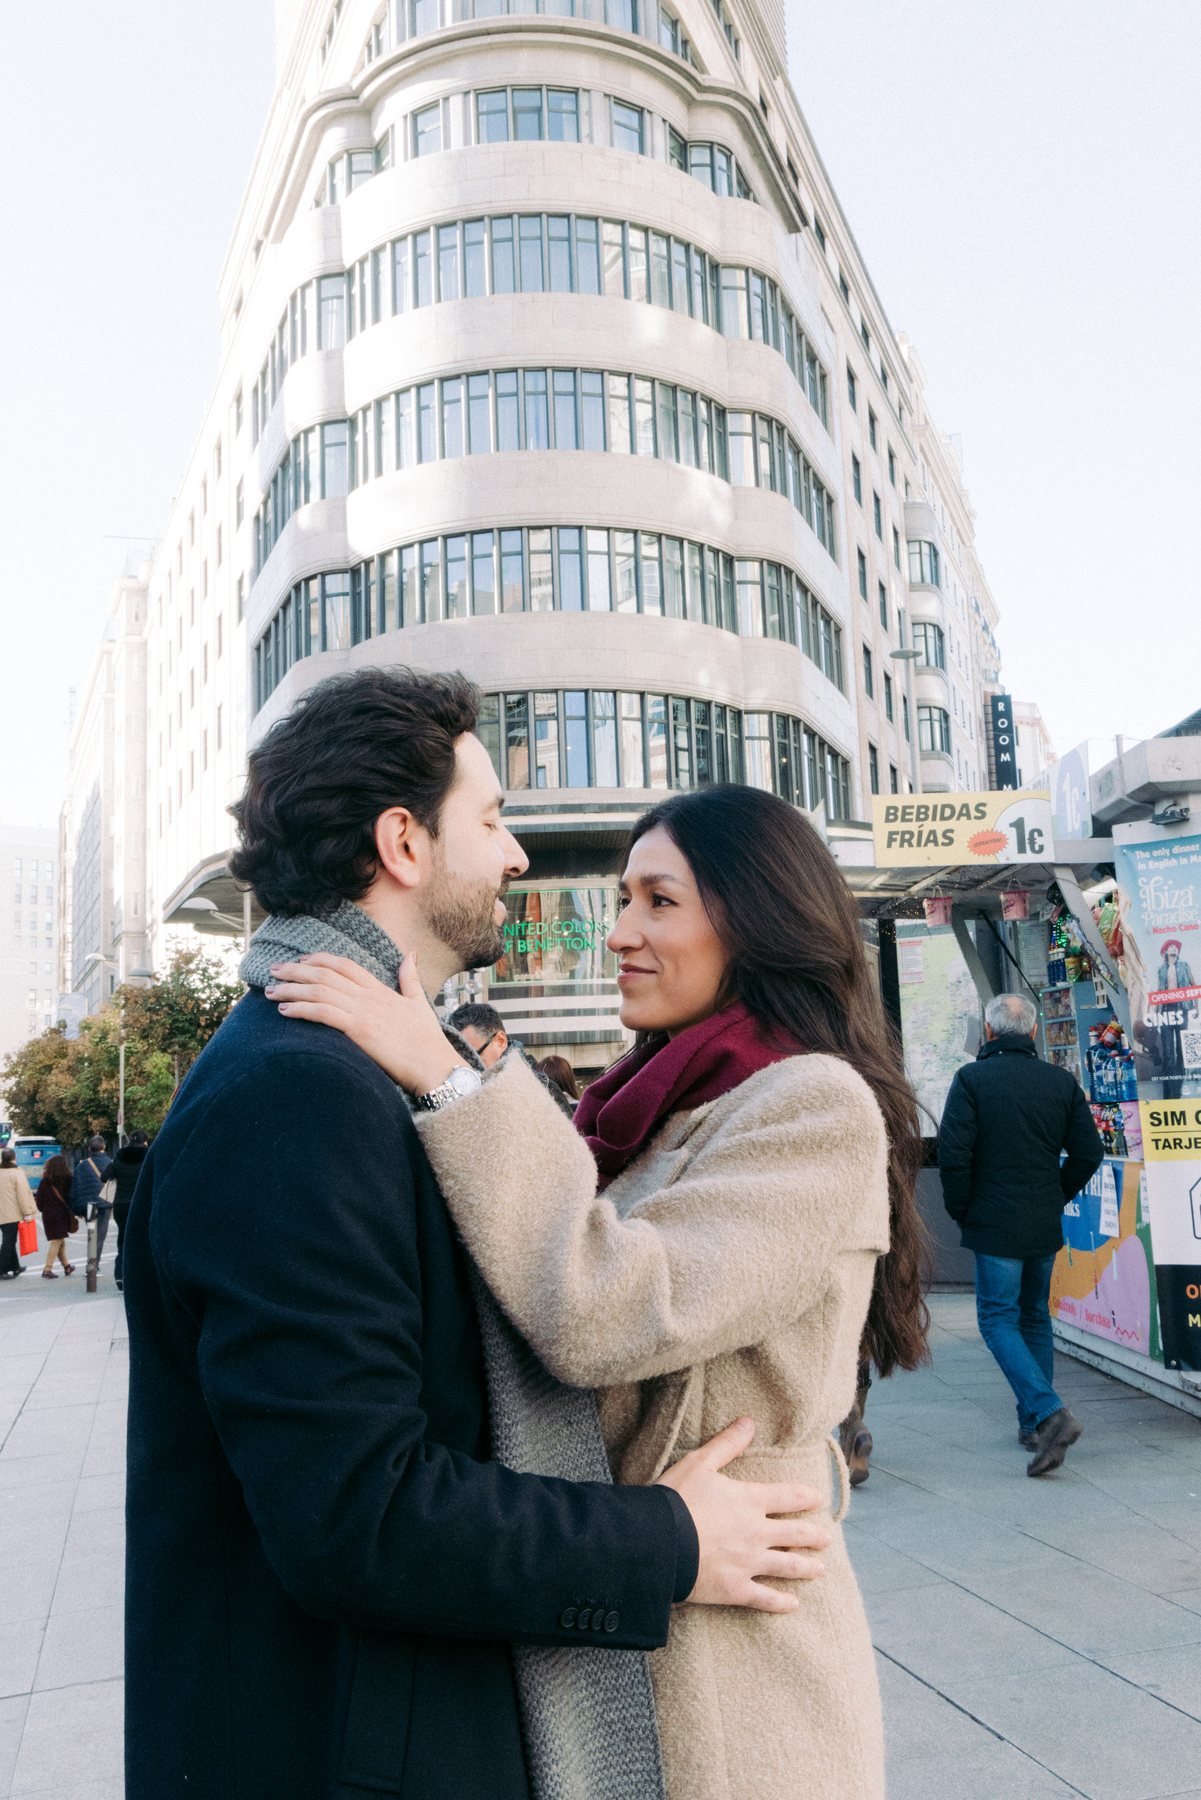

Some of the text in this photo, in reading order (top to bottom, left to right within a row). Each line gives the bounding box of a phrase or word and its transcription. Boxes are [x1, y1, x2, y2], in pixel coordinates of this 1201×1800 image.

[998, 702, 1011, 762] ROOM
[884, 802, 988, 823] BEBIDAS
[886, 824, 955, 849] FRÍAS
[1009, 817, 1044, 855] 1€
[1135, 844, 1200, 859] The only dinner
[1137, 862, 1146, 870] in
[1149, 858, 1177, 870] English
[1180, 857, 1188, 865] in
[1138, 876, 1194, 912] Ibiza
[503, 922, 548, 936] NITED
[1152, 925, 1177, 935] Nacho
[1178, 923, 1199, 932] Cano
[504, 937, 596, 953] F BENETTON
[1151, 990, 1185, 1003] OPENING
[1142, 1009, 1184, 1027] CINES
[1149, 1110, 1187, 1127] SIM
[1151, 1137, 1201, 1150] TARJE
